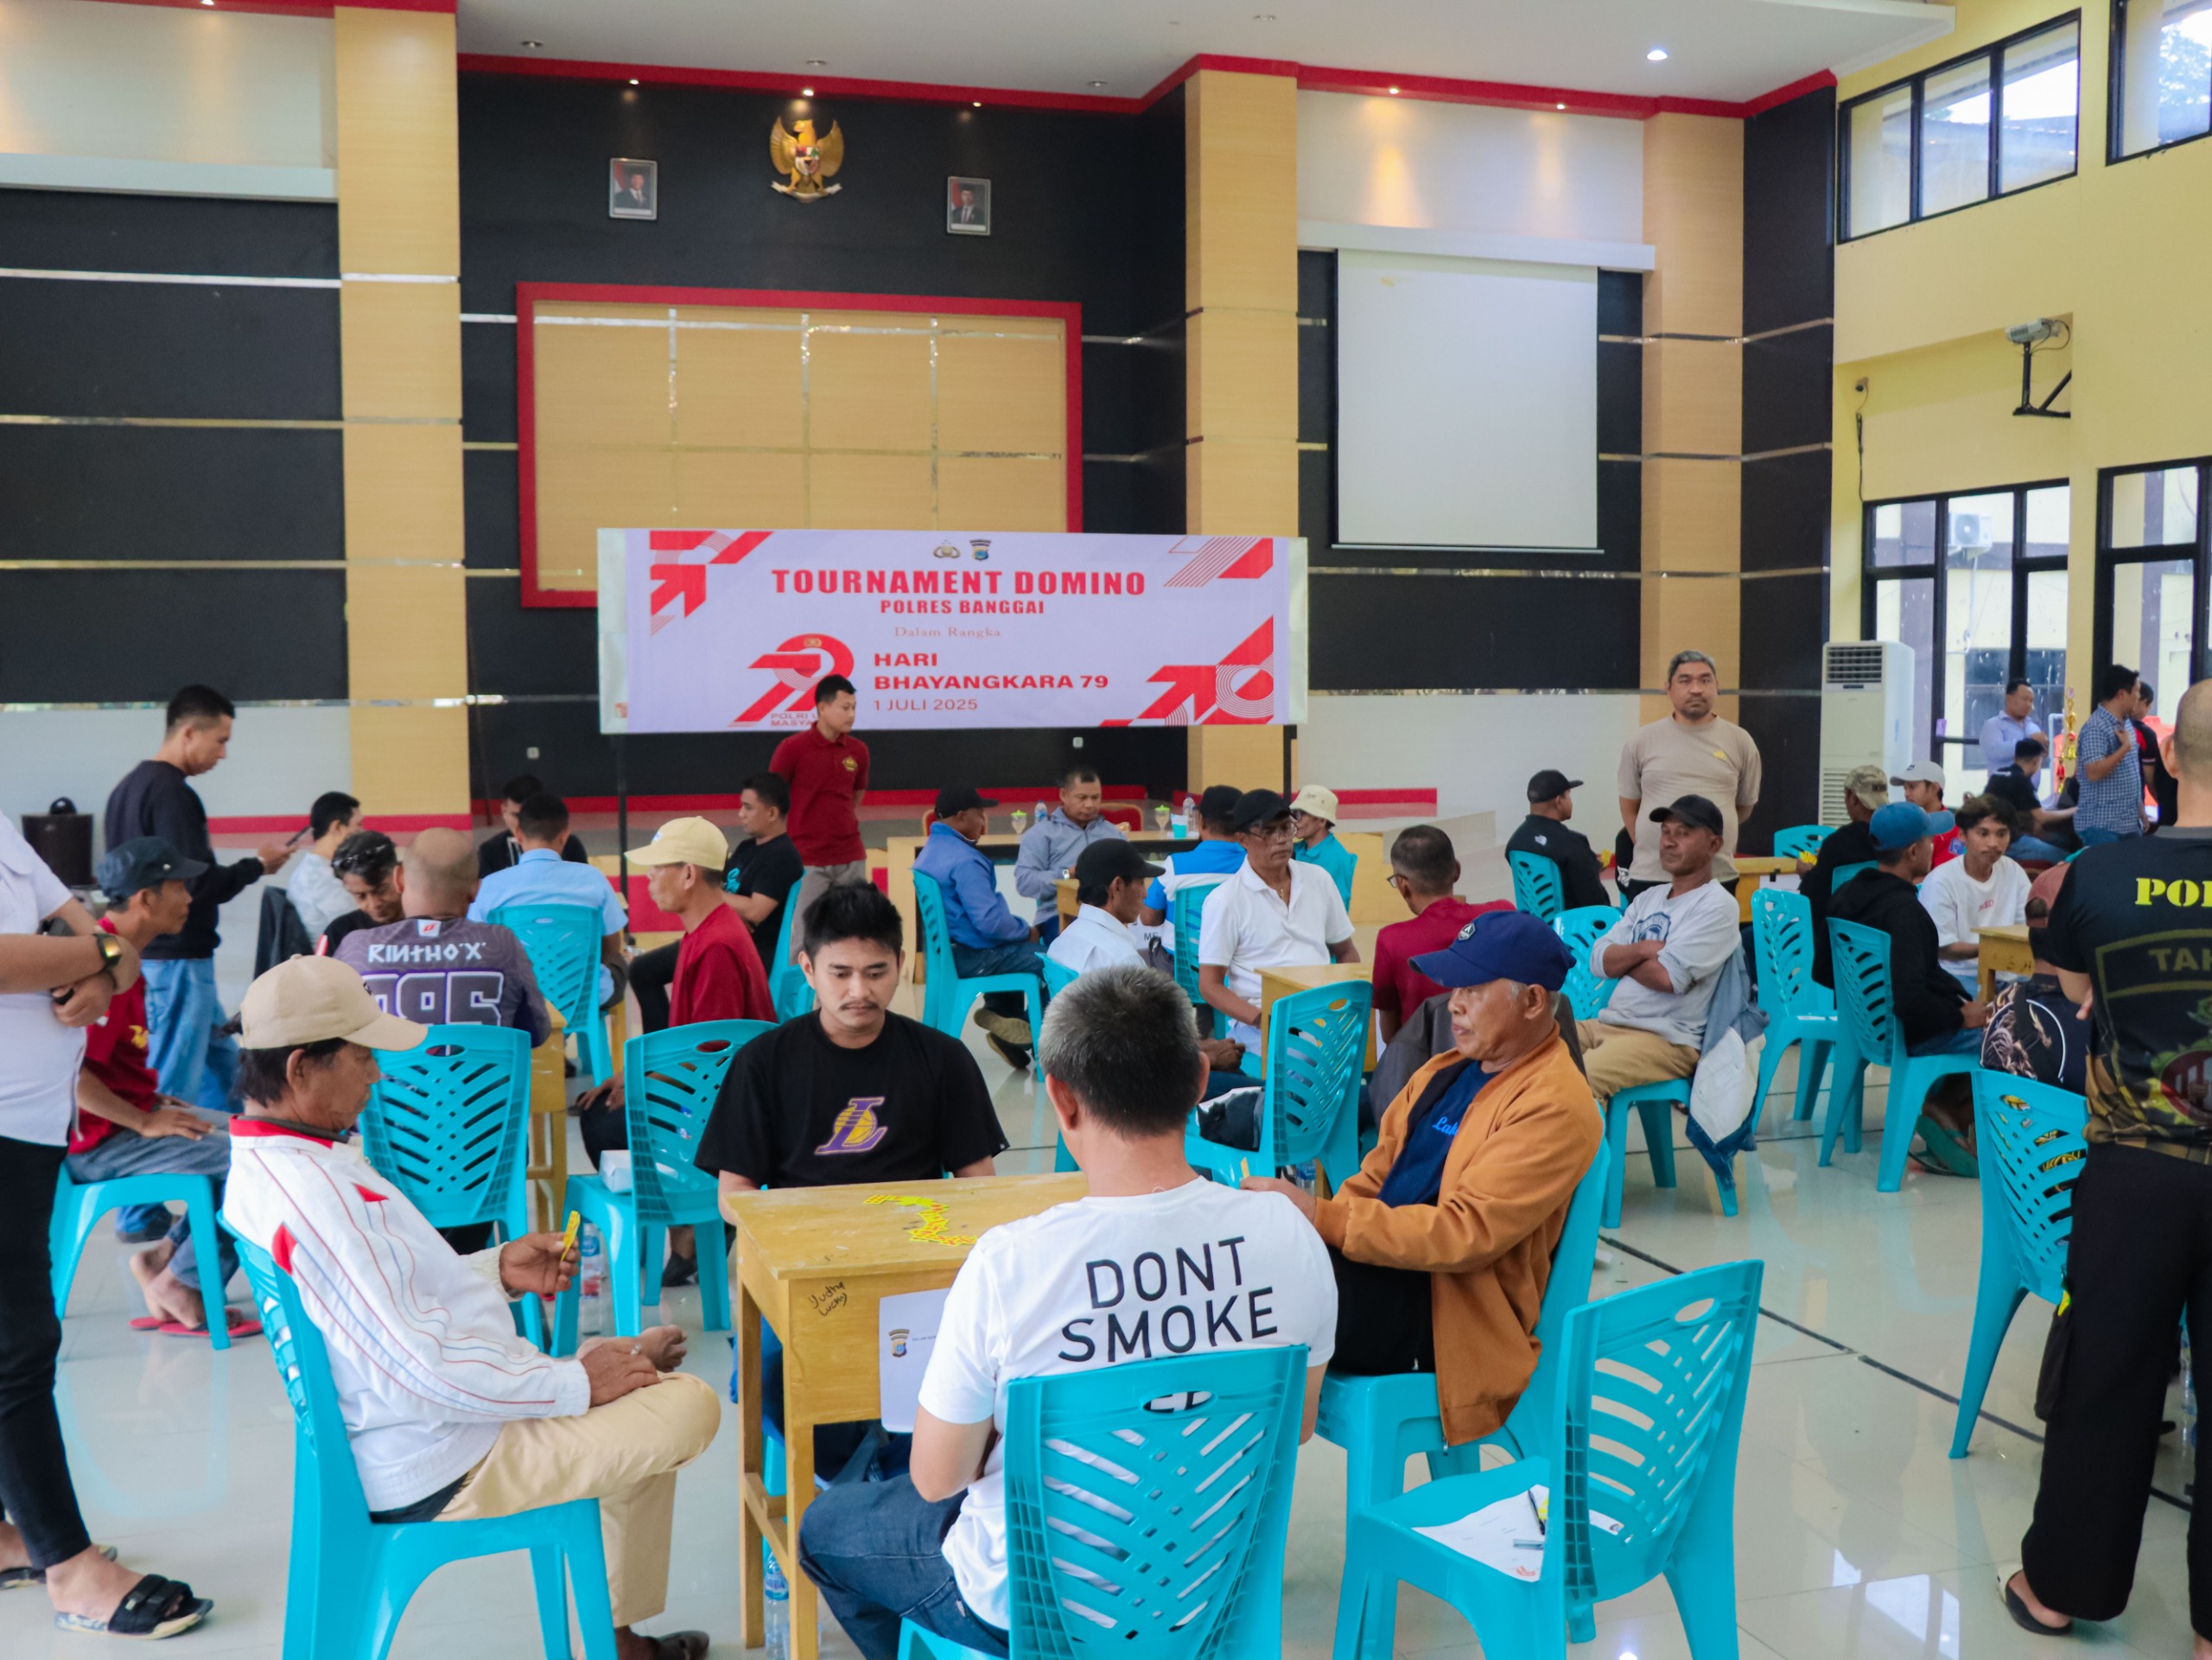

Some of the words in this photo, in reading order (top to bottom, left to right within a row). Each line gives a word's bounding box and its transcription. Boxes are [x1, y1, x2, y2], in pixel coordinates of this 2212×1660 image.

[771, 569, 1002, 595] TOURNAMENT
[1014, 571, 1145, 595] DOMINO
[880, 600, 952, 614] POLRES
[959, 601, 1045, 614] BANGGAI
[894, 626, 941, 637] Dalam
[948, 627, 1001, 639] Rangka
[874, 652, 938, 667] HARI
[874, 675, 1074, 690] BHAYANGKARA
[1079, 675, 1109, 689] 79
[874, 700, 880, 710] 1
[887, 699, 926, 710] JULI
[933, 699, 978, 710] 2025
[1086, 1236, 1245, 1309] DONT
[1058, 1286, 1278, 1363] SMOKE
